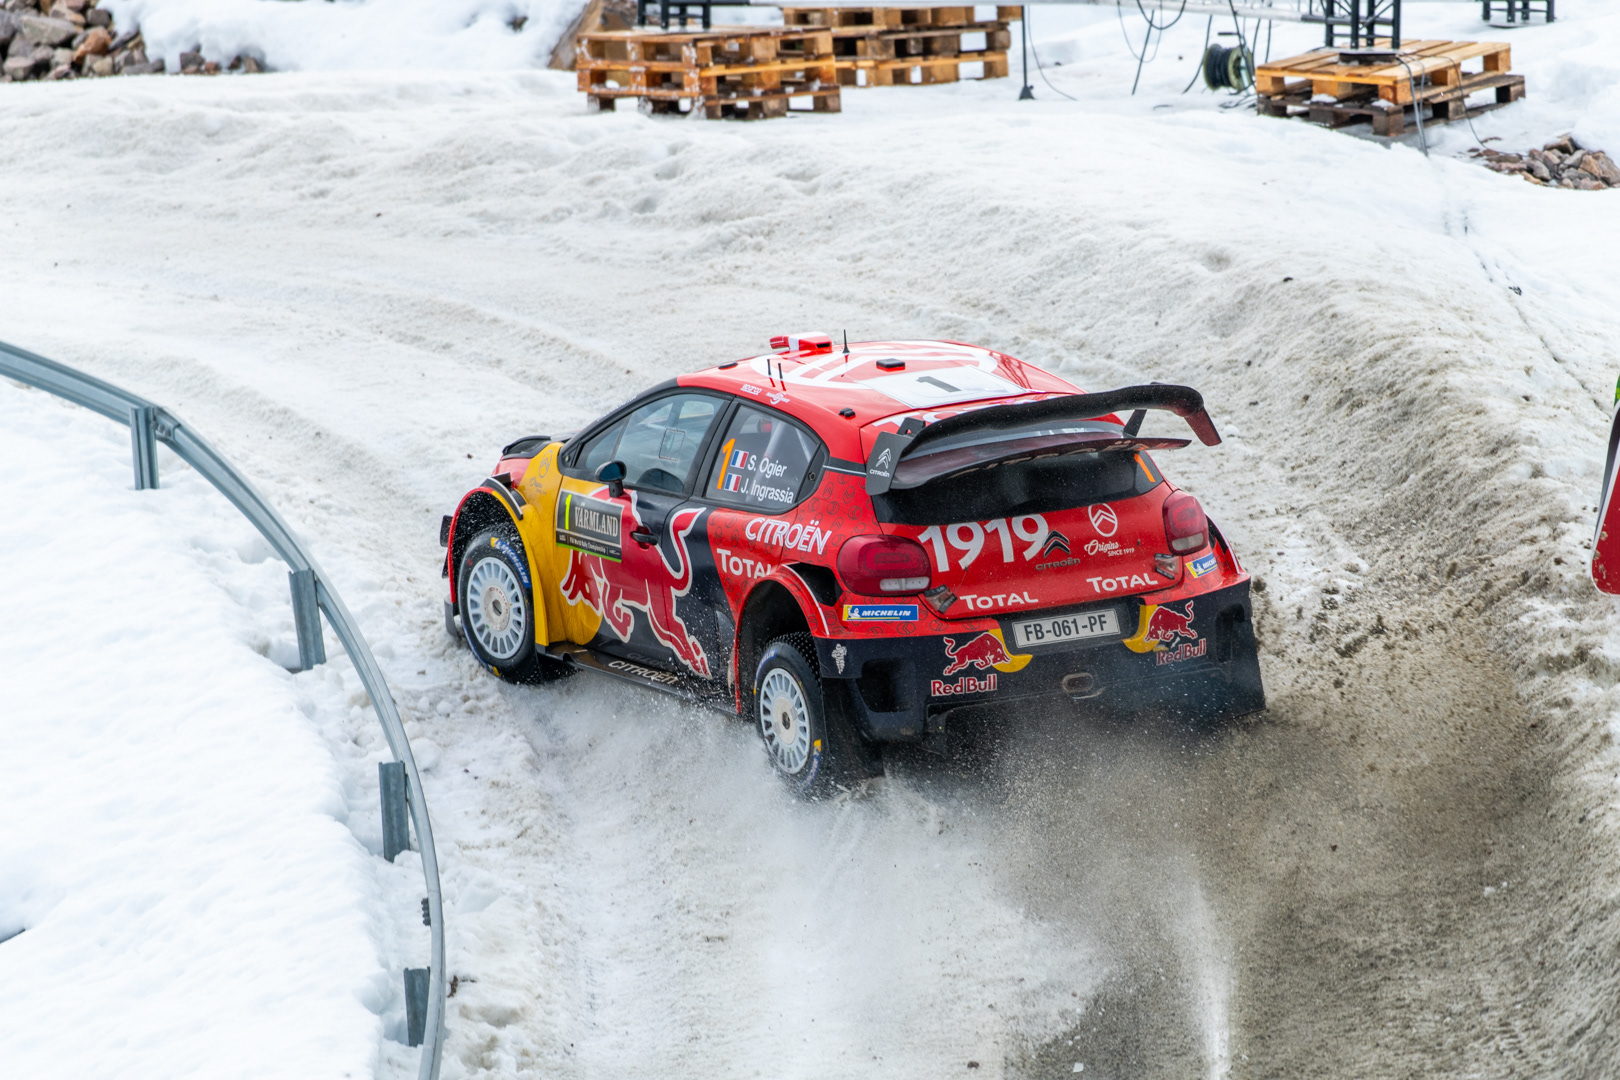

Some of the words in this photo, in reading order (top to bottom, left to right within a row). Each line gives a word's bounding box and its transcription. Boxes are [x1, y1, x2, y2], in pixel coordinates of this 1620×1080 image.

[717, 438, 736, 490] 1
[747, 455, 757, 471] S.
[759, 457, 787, 478] Ogier
[740, 478, 749, 495] J.
[750, 479, 794, 504] Ingrassia
[565, 494, 572, 530] 1
[574, 502, 619, 537] VÄRMLAND
[745, 517, 832, 555] CITROËN
[917, 514, 1049, 573] 1919
[1084, 539, 1120, 556] Origins
[1107, 549, 1123, 557] SINCE
[1086, 573, 1158, 594] TOTAL
[959, 591, 1039, 611] TOTAL
[1023, 614, 1108, 642] FB-061-PF
[1156, 646, 1183, 666] Red
[1183, 638, 1207, 661] Bull
[931, 676, 965, 697] Red
[965, 673, 998, 693] Bull
